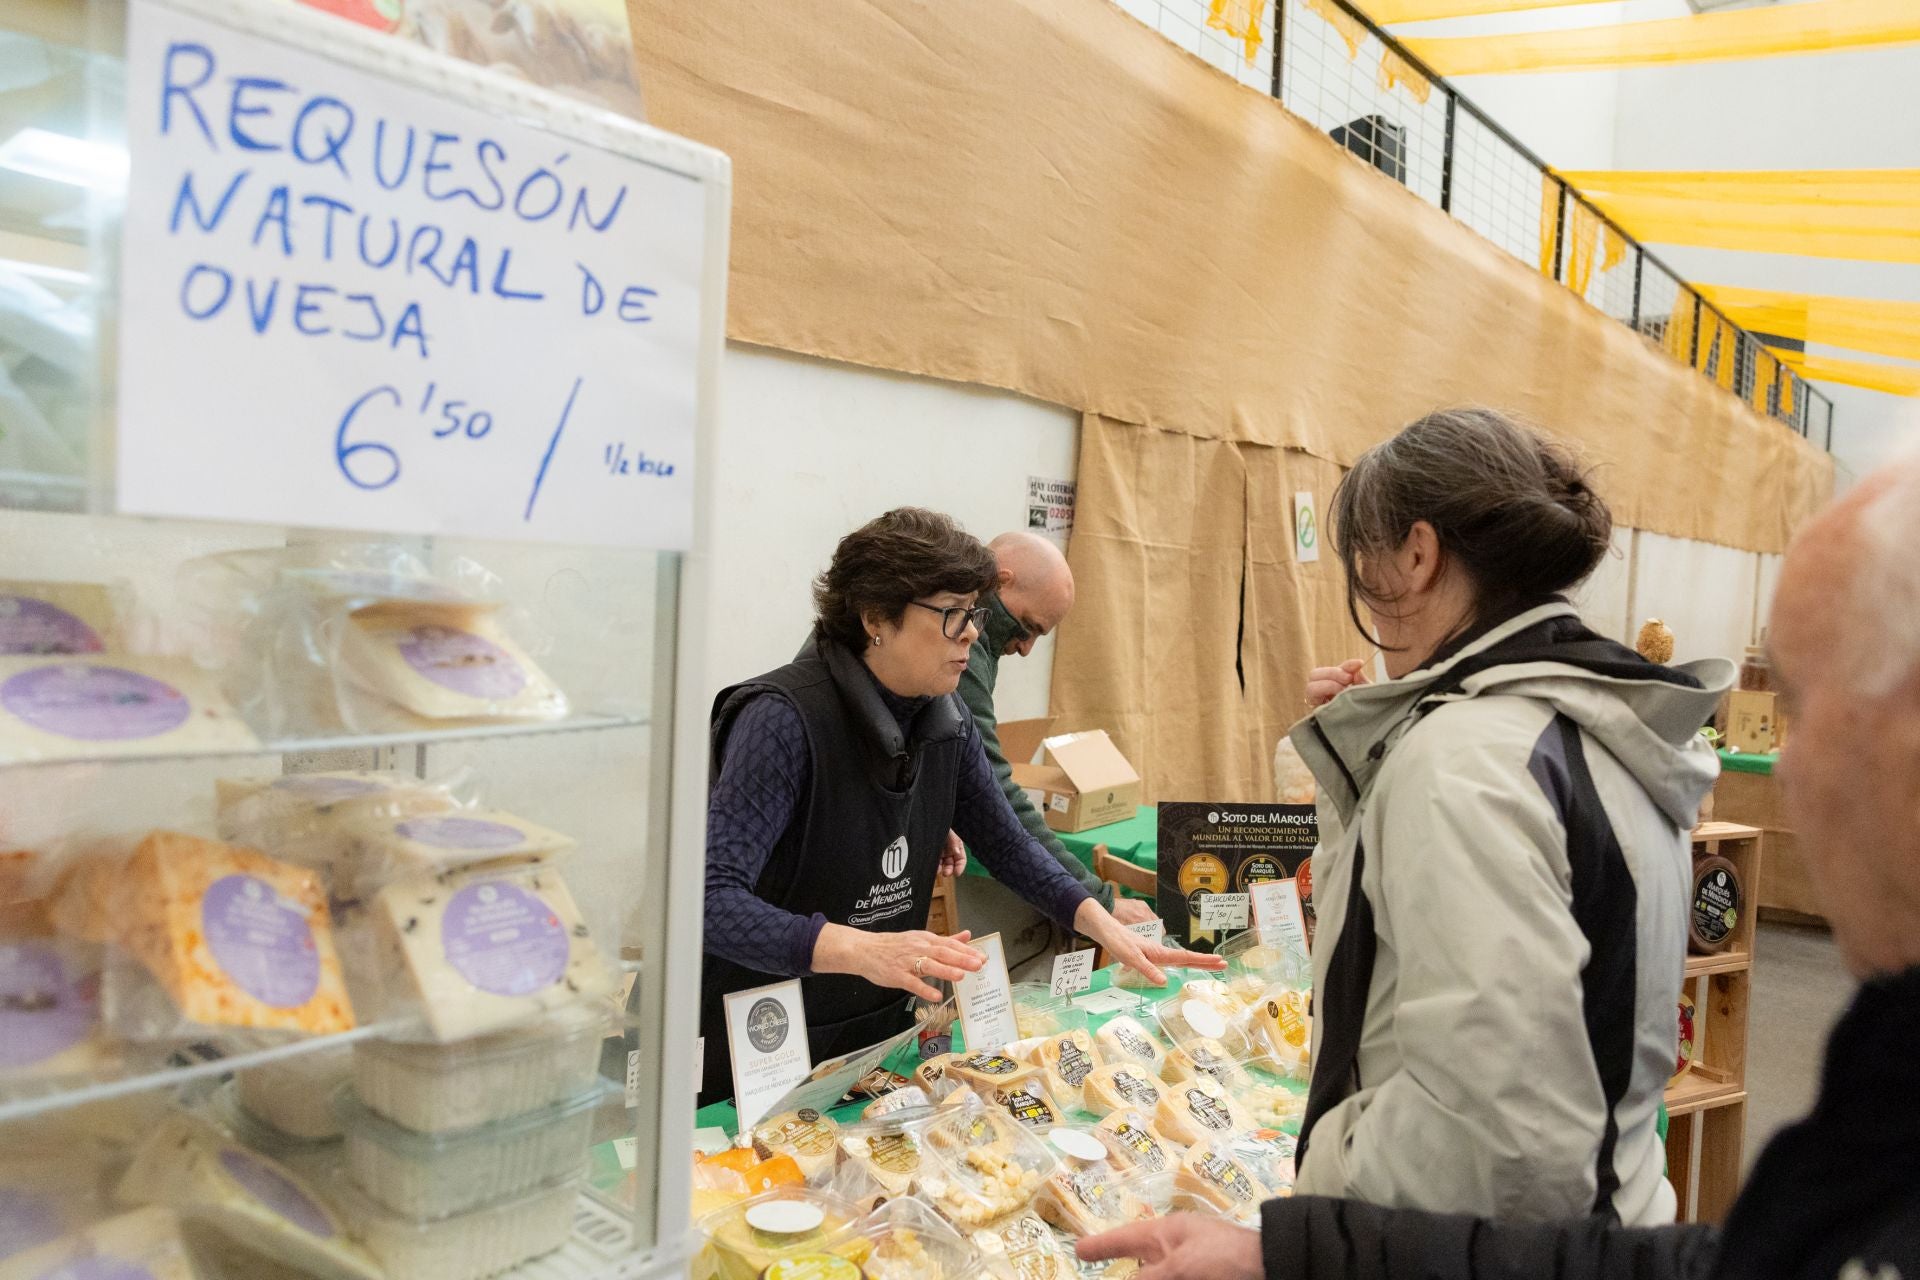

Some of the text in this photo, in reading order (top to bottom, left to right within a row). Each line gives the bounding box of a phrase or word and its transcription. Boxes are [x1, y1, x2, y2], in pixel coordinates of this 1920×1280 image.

[160, 41, 628, 233] REQUESÓN
[169, 168, 659, 323] NATURAL DE
[179, 264, 430, 359] OVEJA
[1030, 481, 1045, 491] HAY
[1040, 493, 1073, 506] NAVIDAD
[1221, 811, 1318, 825] SOTO DEL MARQUÉS
[1218, 825, 1310, 835] UN RECONOCIMIENTO
[1192, 834, 1231, 842] MUNDIAL
[1233, 834, 1243, 842] AL
[1244, 835, 1270, 843] VALOR
[1272, 835, 1283, 843] DE
[869, 877, 911, 897] MARQUÉS
[855, 887, 912, 909] DE MENDIOLA
[747, 1022, 769, 1033] WORLD
